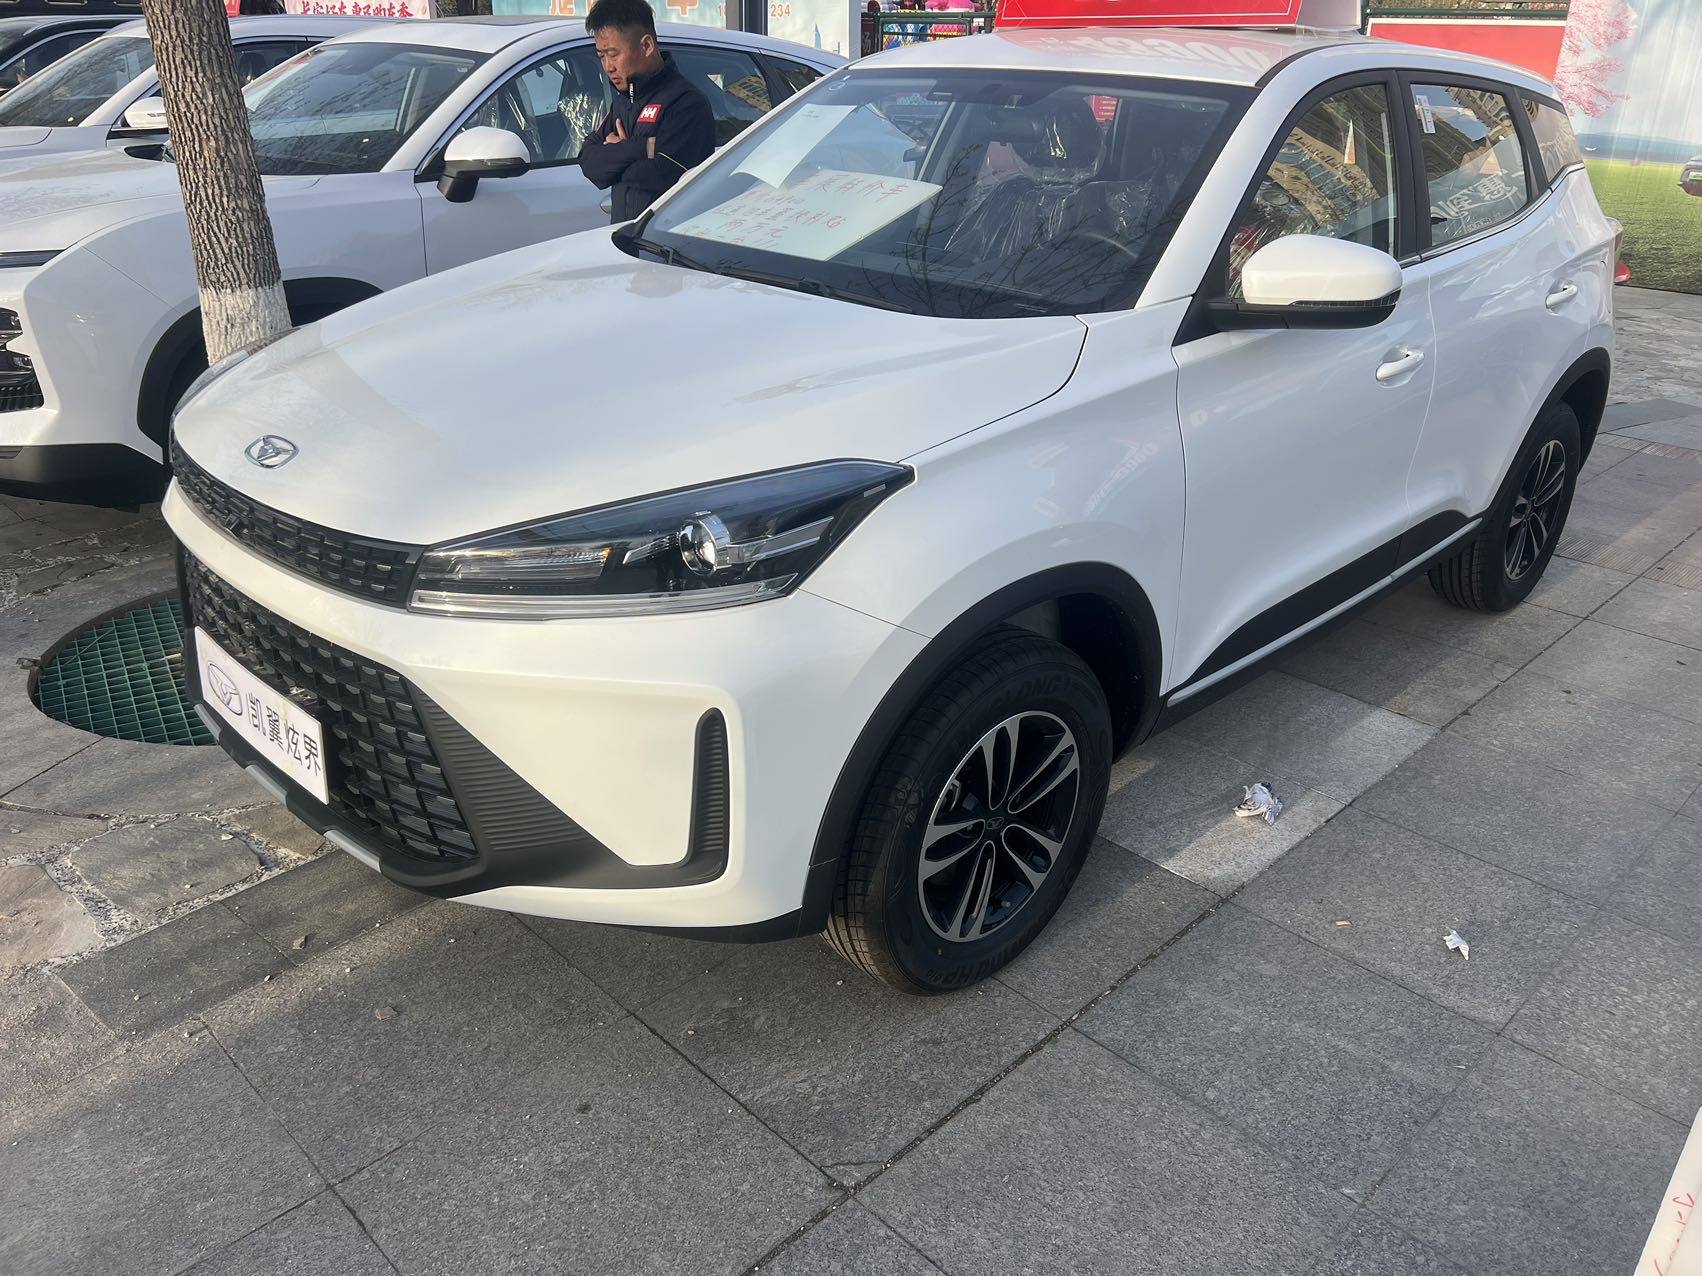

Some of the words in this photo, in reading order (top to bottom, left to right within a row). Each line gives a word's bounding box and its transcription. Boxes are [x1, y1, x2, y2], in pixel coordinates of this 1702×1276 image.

[770, 4, 791, 17] 234
[640, 107, 658, 119] HH
[246, 692, 322, 776] 凯翼炫界
